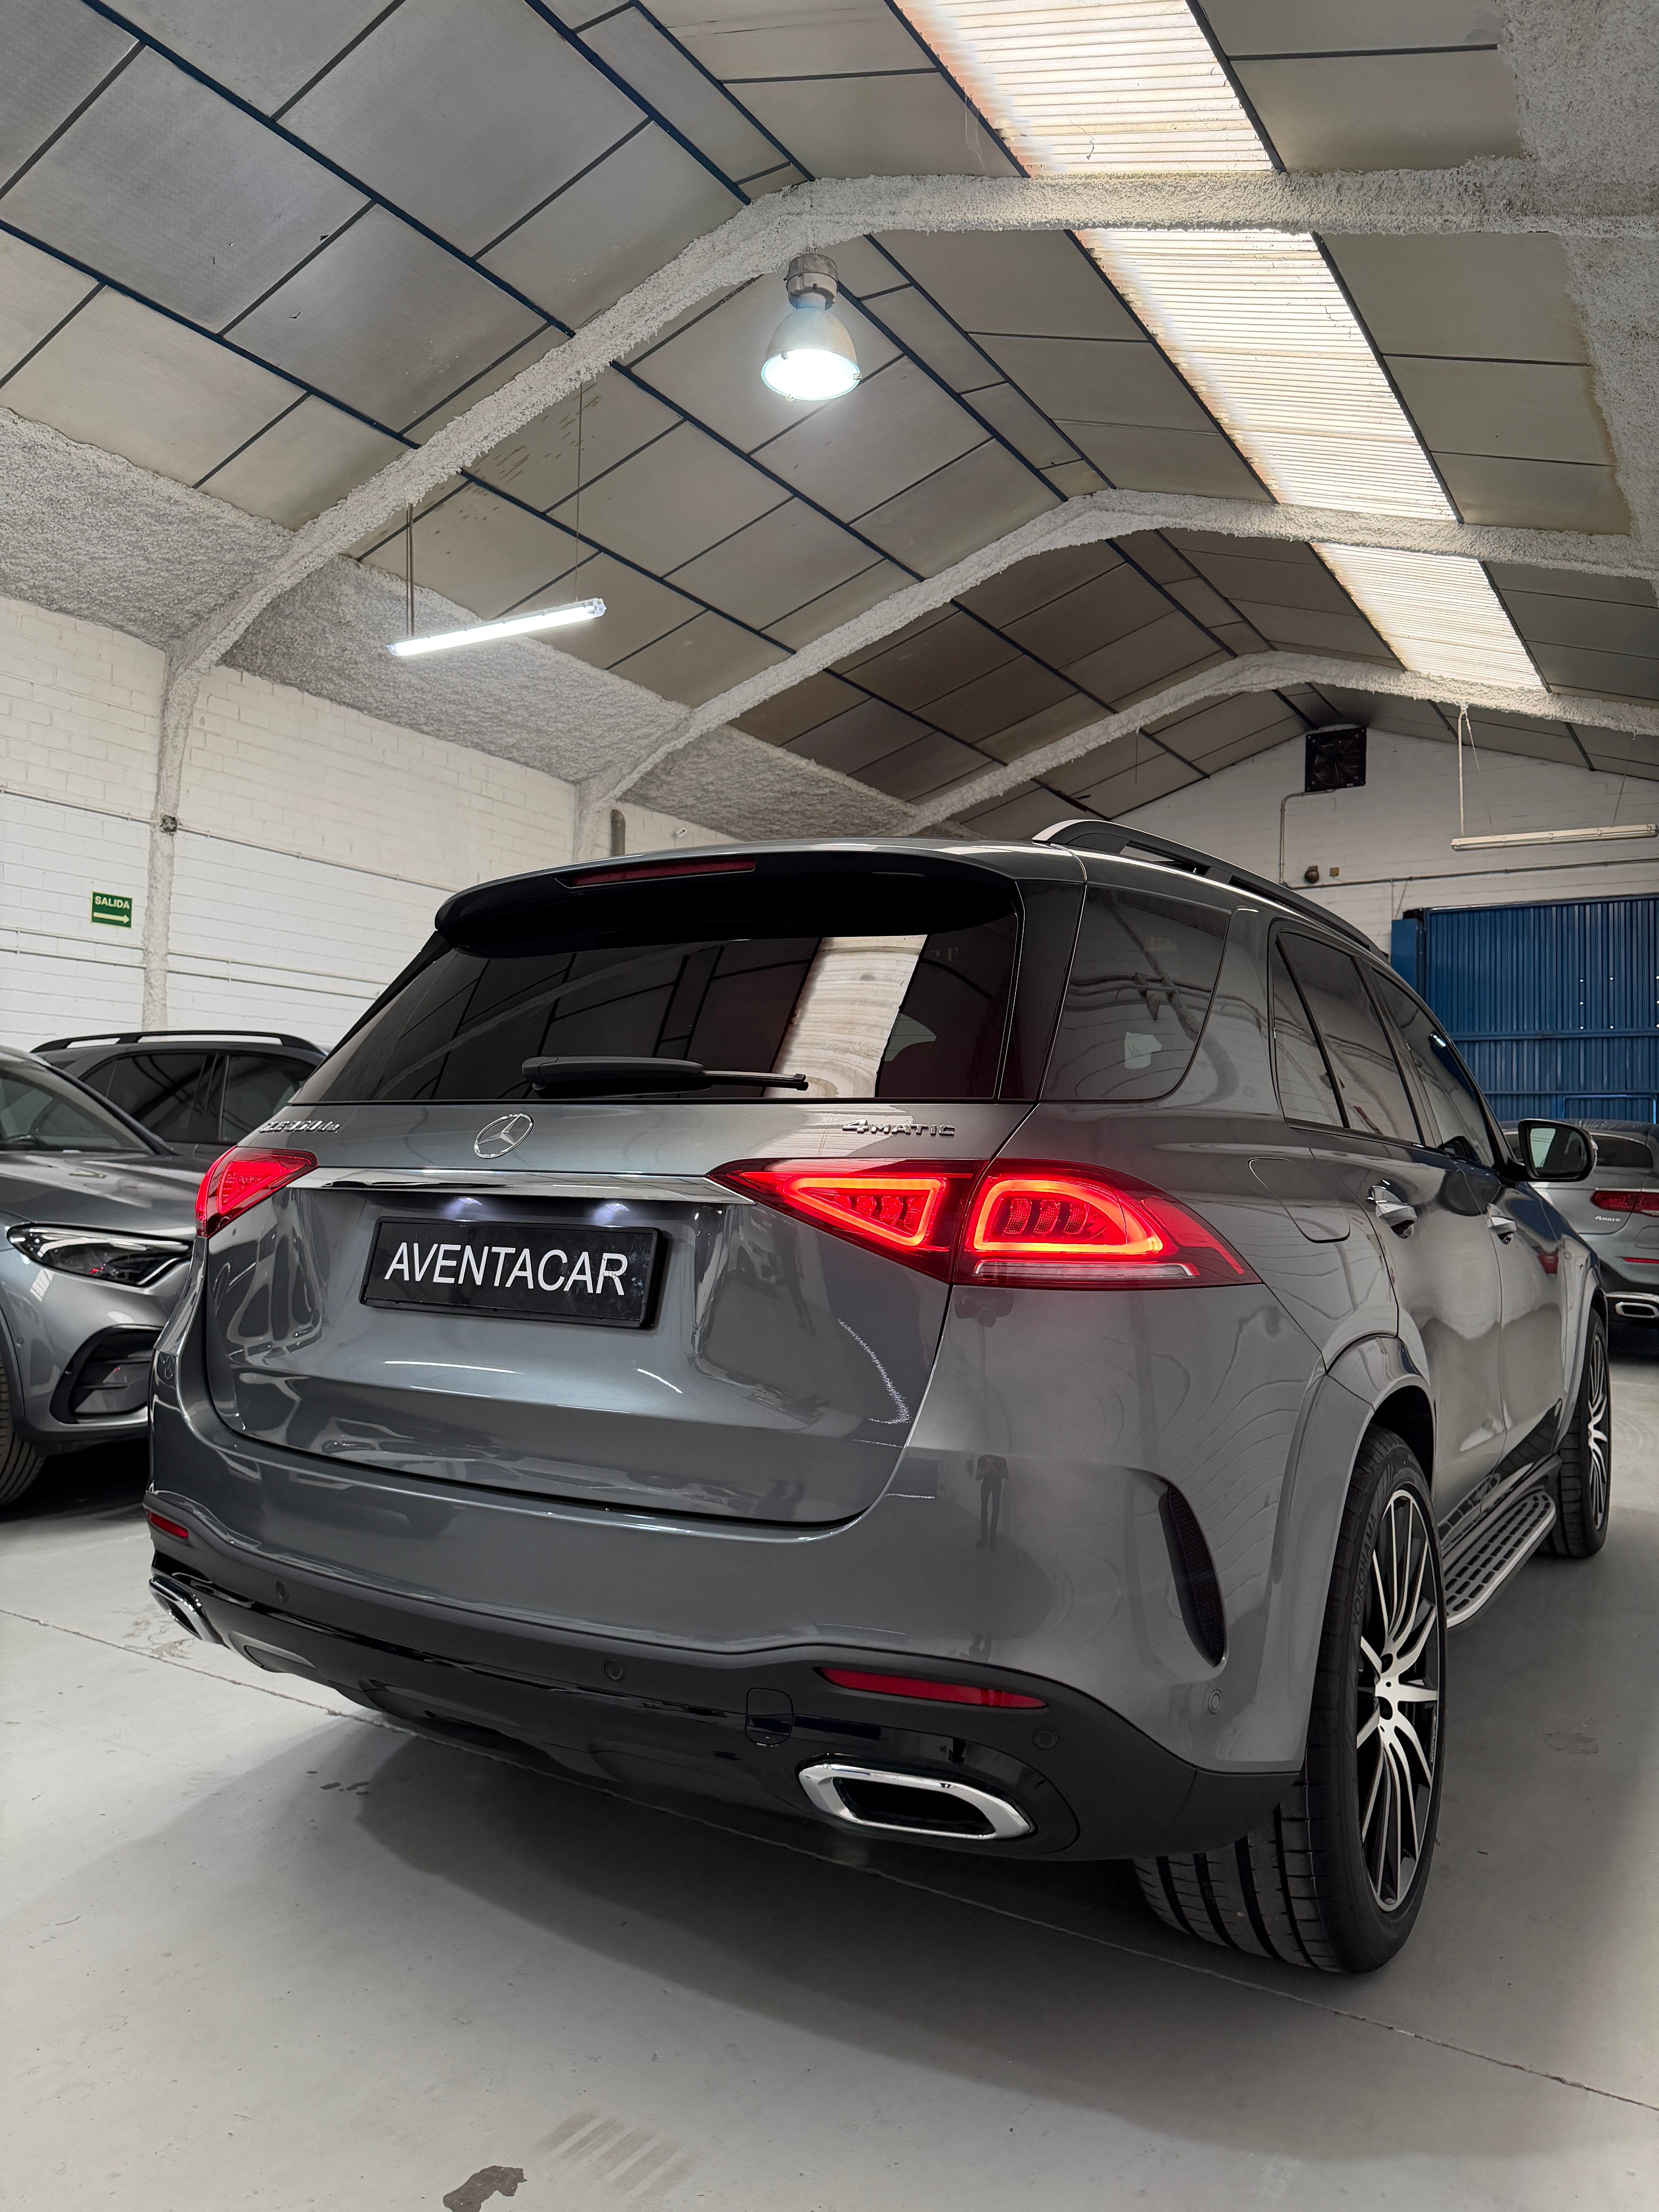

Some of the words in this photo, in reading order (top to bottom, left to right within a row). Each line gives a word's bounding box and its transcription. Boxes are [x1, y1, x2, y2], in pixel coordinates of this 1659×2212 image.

[95, 896, 130, 909] SALIDA
[842, 1119, 955, 1135] 4MATIC
[384, 1242, 628, 1296] AVENTACAR
[1352, 1513, 1377, 1626] YOKOHAMA
